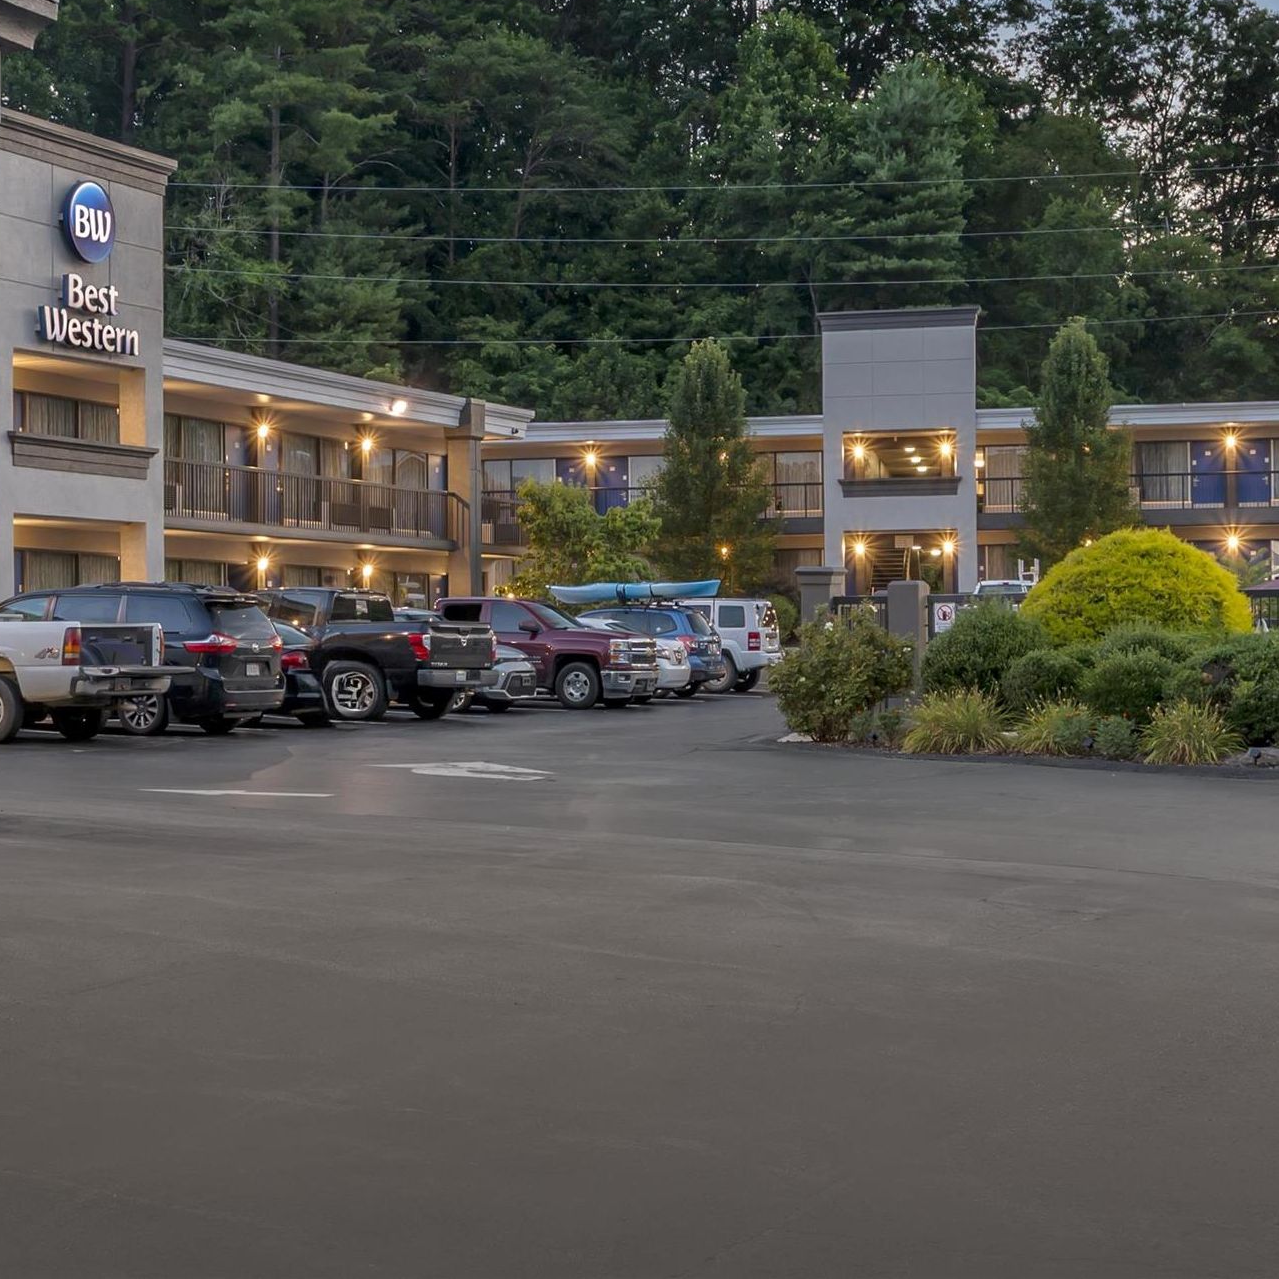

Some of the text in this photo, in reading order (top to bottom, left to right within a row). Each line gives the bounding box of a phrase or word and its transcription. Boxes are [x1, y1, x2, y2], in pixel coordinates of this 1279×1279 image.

[74, 204, 112, 244] BW
[67, 273, 120, 316] Best
[42, 304, 140, 356] Western
